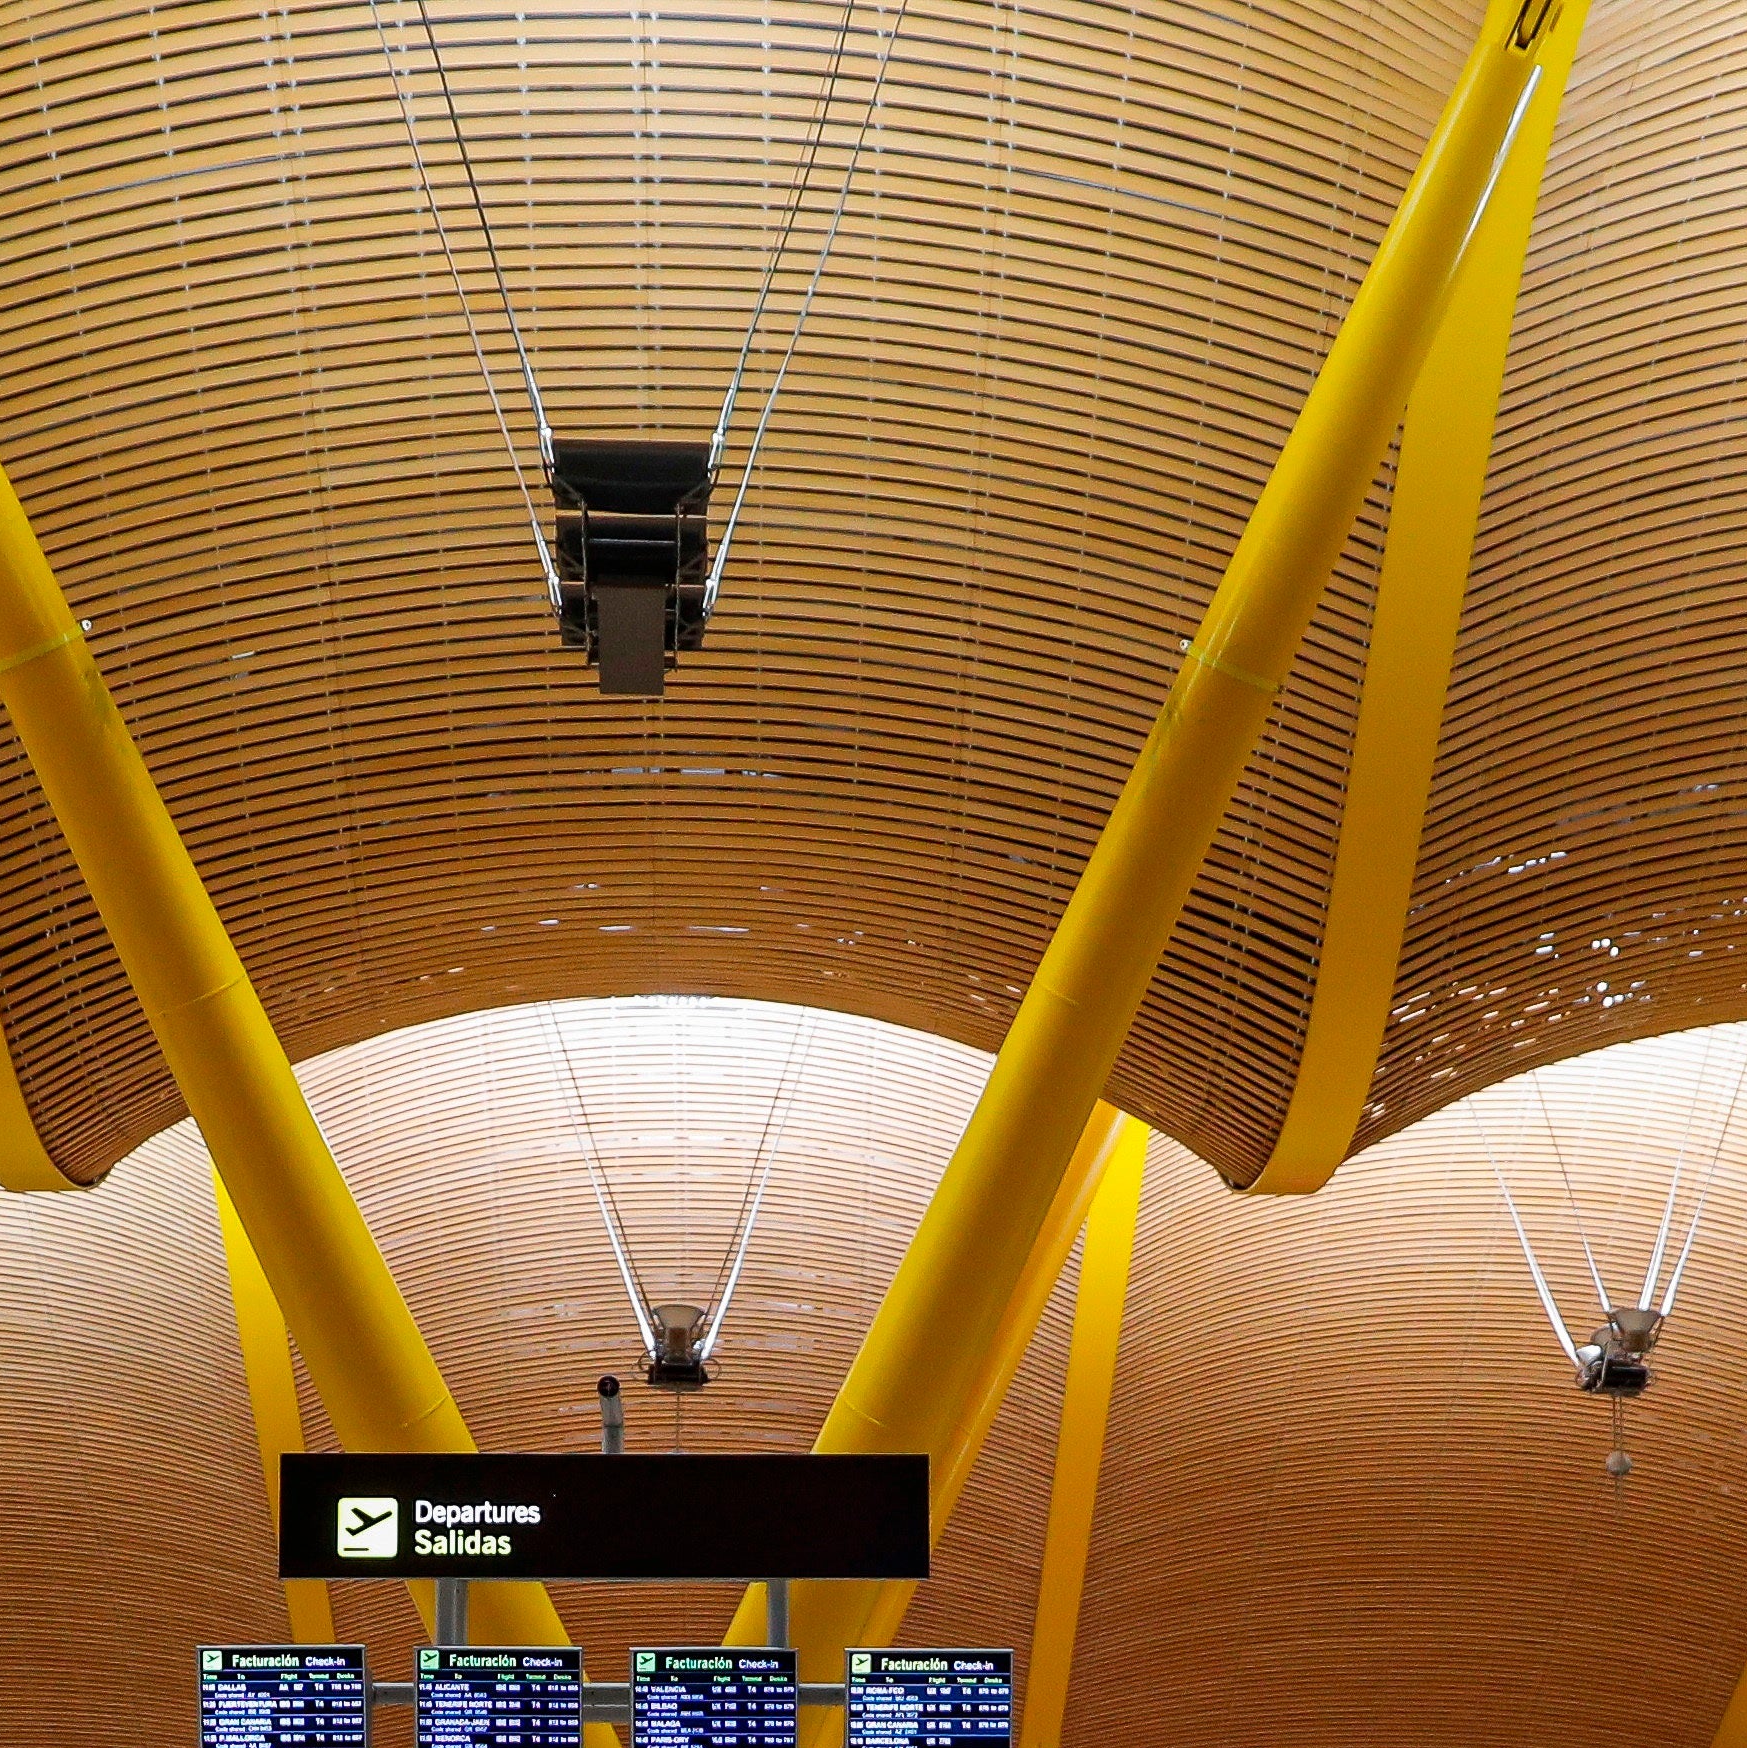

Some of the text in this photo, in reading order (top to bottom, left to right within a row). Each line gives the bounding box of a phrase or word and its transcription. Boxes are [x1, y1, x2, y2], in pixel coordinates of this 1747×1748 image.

[415, 1500, 541, 1528] Departures
[414, 1529, 512, 1555] Salidas
[233, 1655, 345, 1667] Facturación Check-in
[450, 1655, 562, 1666] Facturación Check-in
[666, 1657, 778, 1669] Facturación Check-in
[882, 1658, 993, 1670] Facturación Check-in
